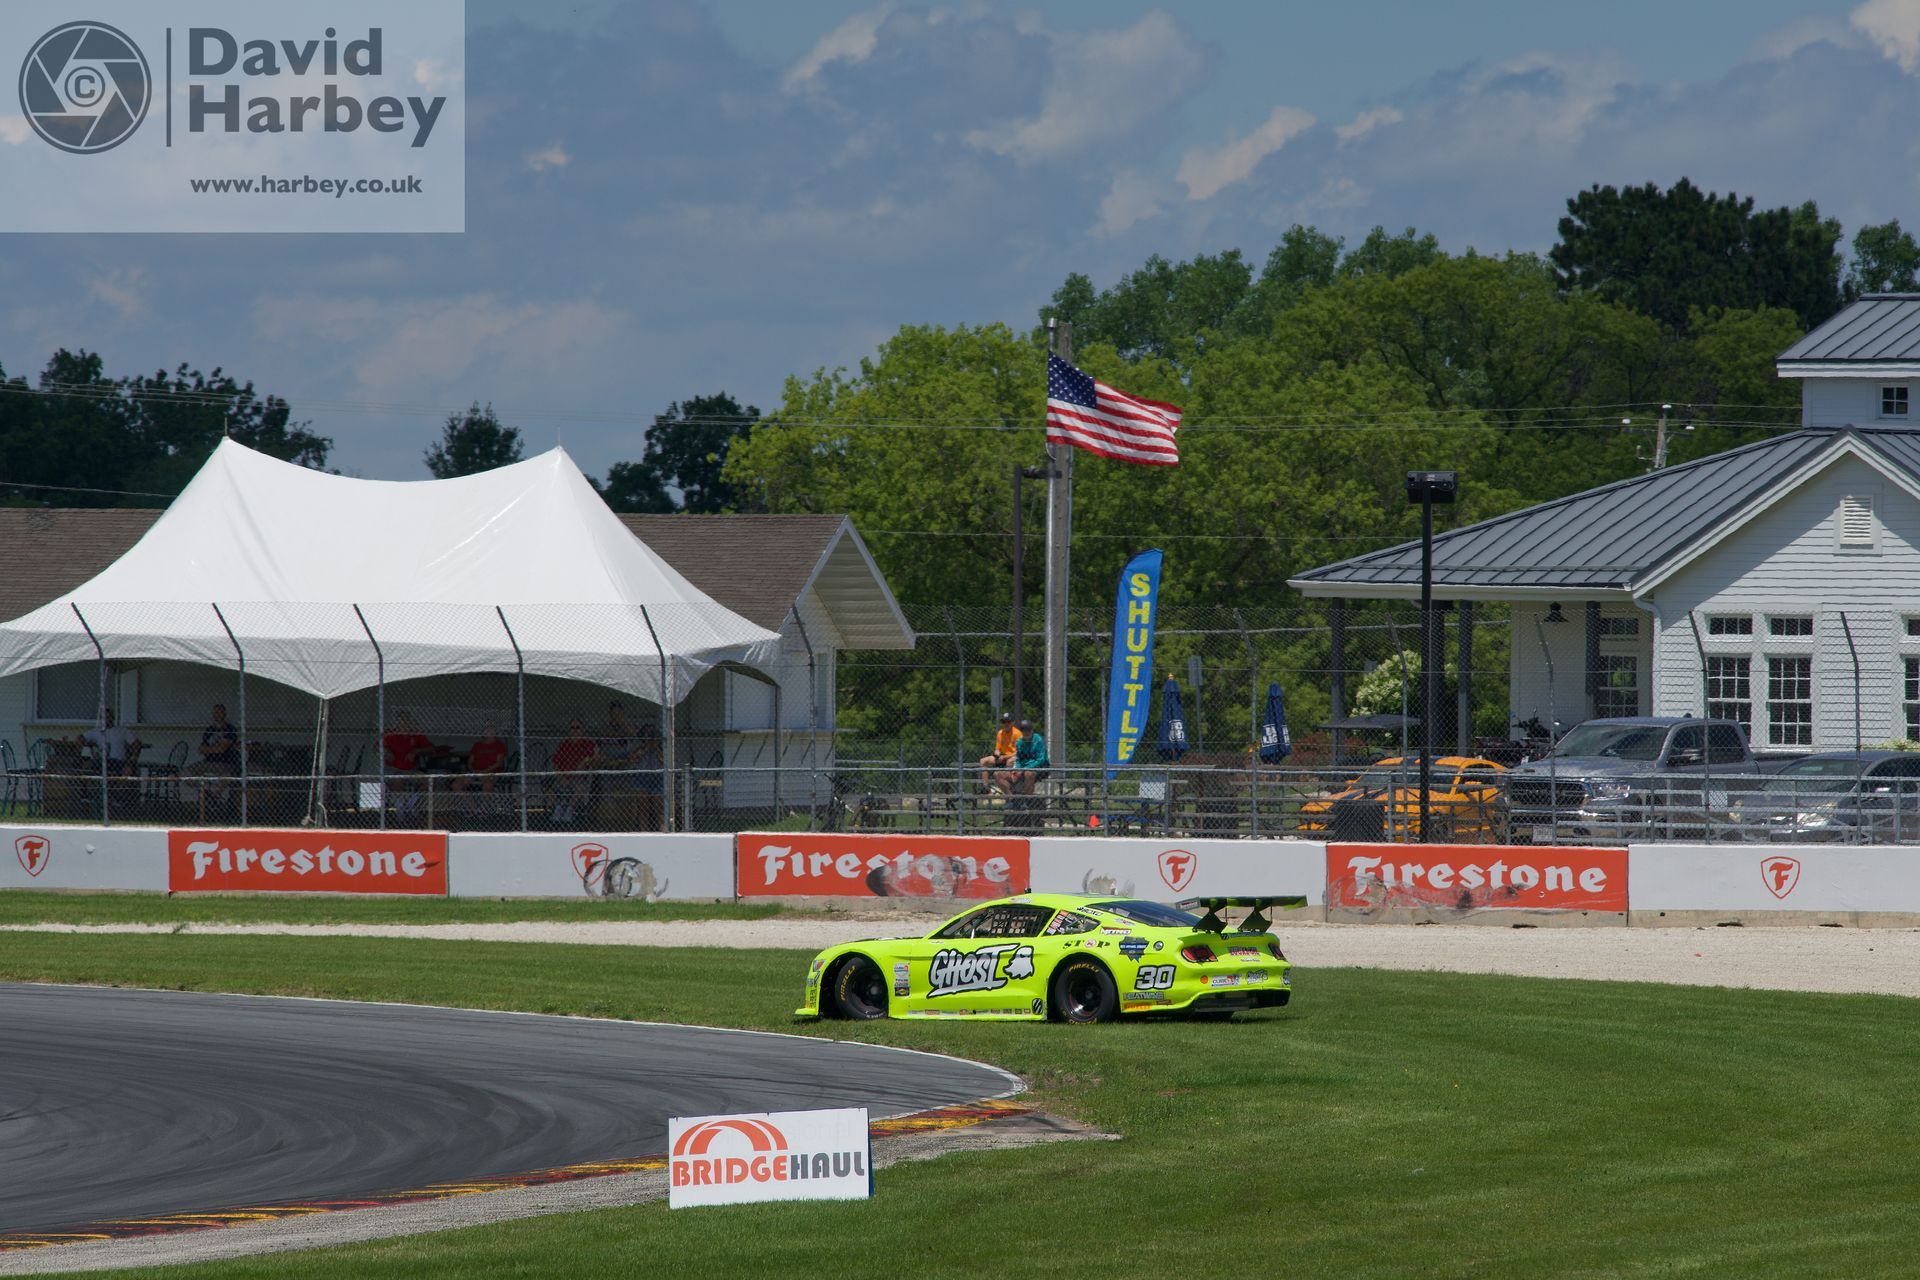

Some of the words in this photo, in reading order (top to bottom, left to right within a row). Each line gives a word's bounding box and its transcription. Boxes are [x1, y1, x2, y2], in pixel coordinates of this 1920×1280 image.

[1118, 573, 1150, 760] SHUTTLE
[186, 841, 428, 880] Firestone
[757, 845, 1012, 886] Firestone
[1347, 856, 1607, 896] Firestone
[926, 943, 1020, 998] GHOST
[1134, 964, 1177, 990] 30
[672, 1152, 865, 1187] BRIDGEHAUL
